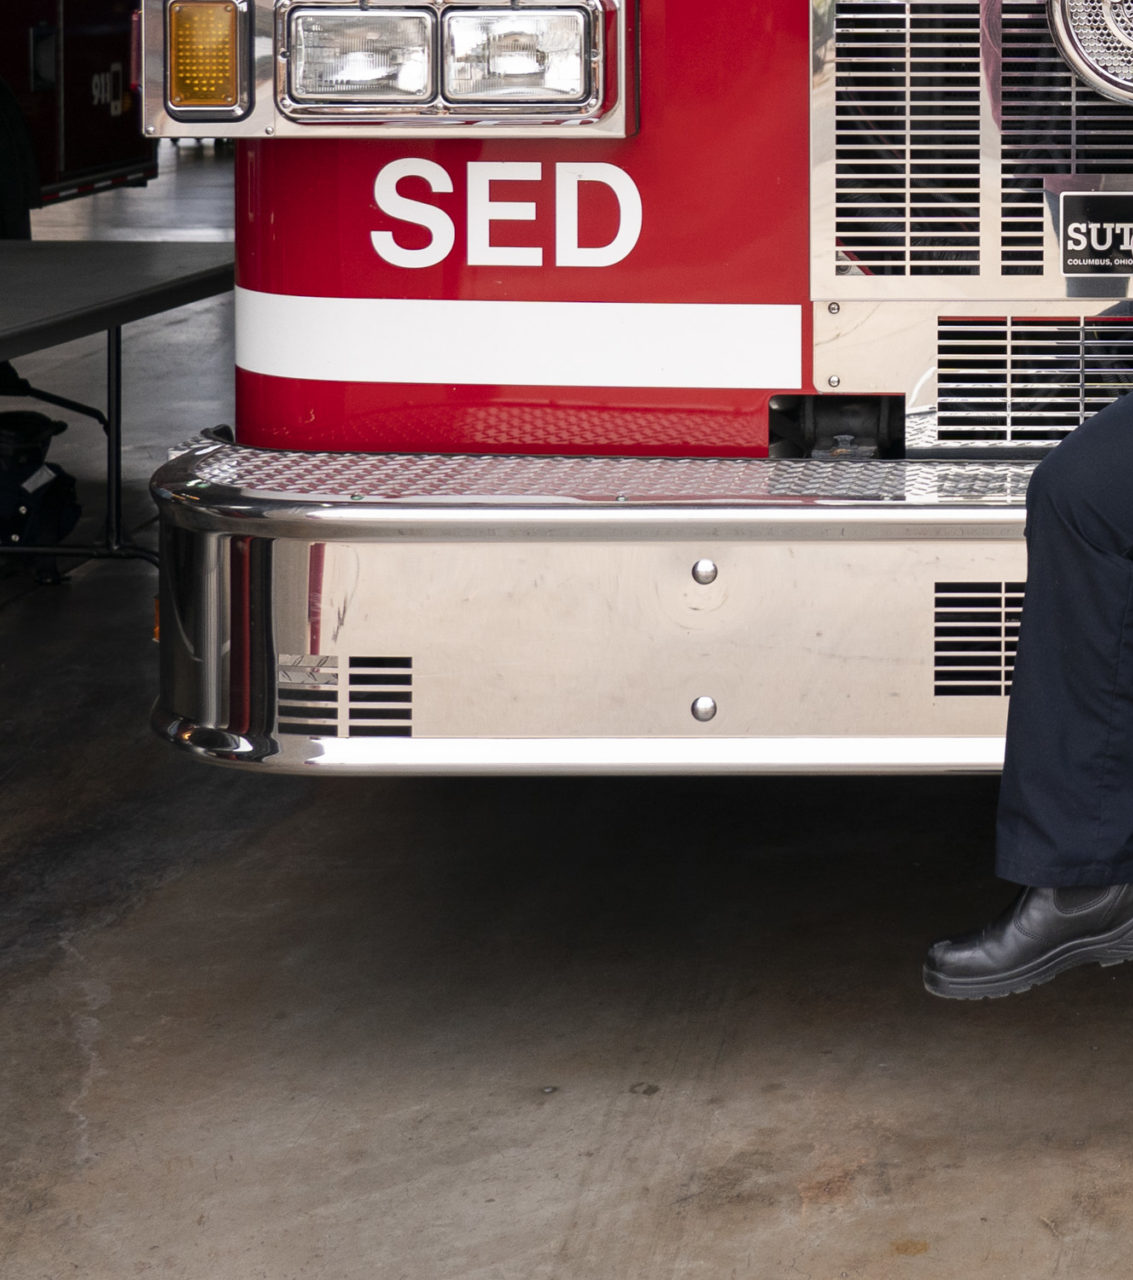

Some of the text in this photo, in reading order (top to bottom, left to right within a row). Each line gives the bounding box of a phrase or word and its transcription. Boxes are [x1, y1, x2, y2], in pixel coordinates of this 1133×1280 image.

[92, 72, 111, 105] 911
[370, 157, 643, 269] SED
[1067, 258, 1113, 266] COLUMBUS,
[1114, 258, 1133, 266] OHIO
